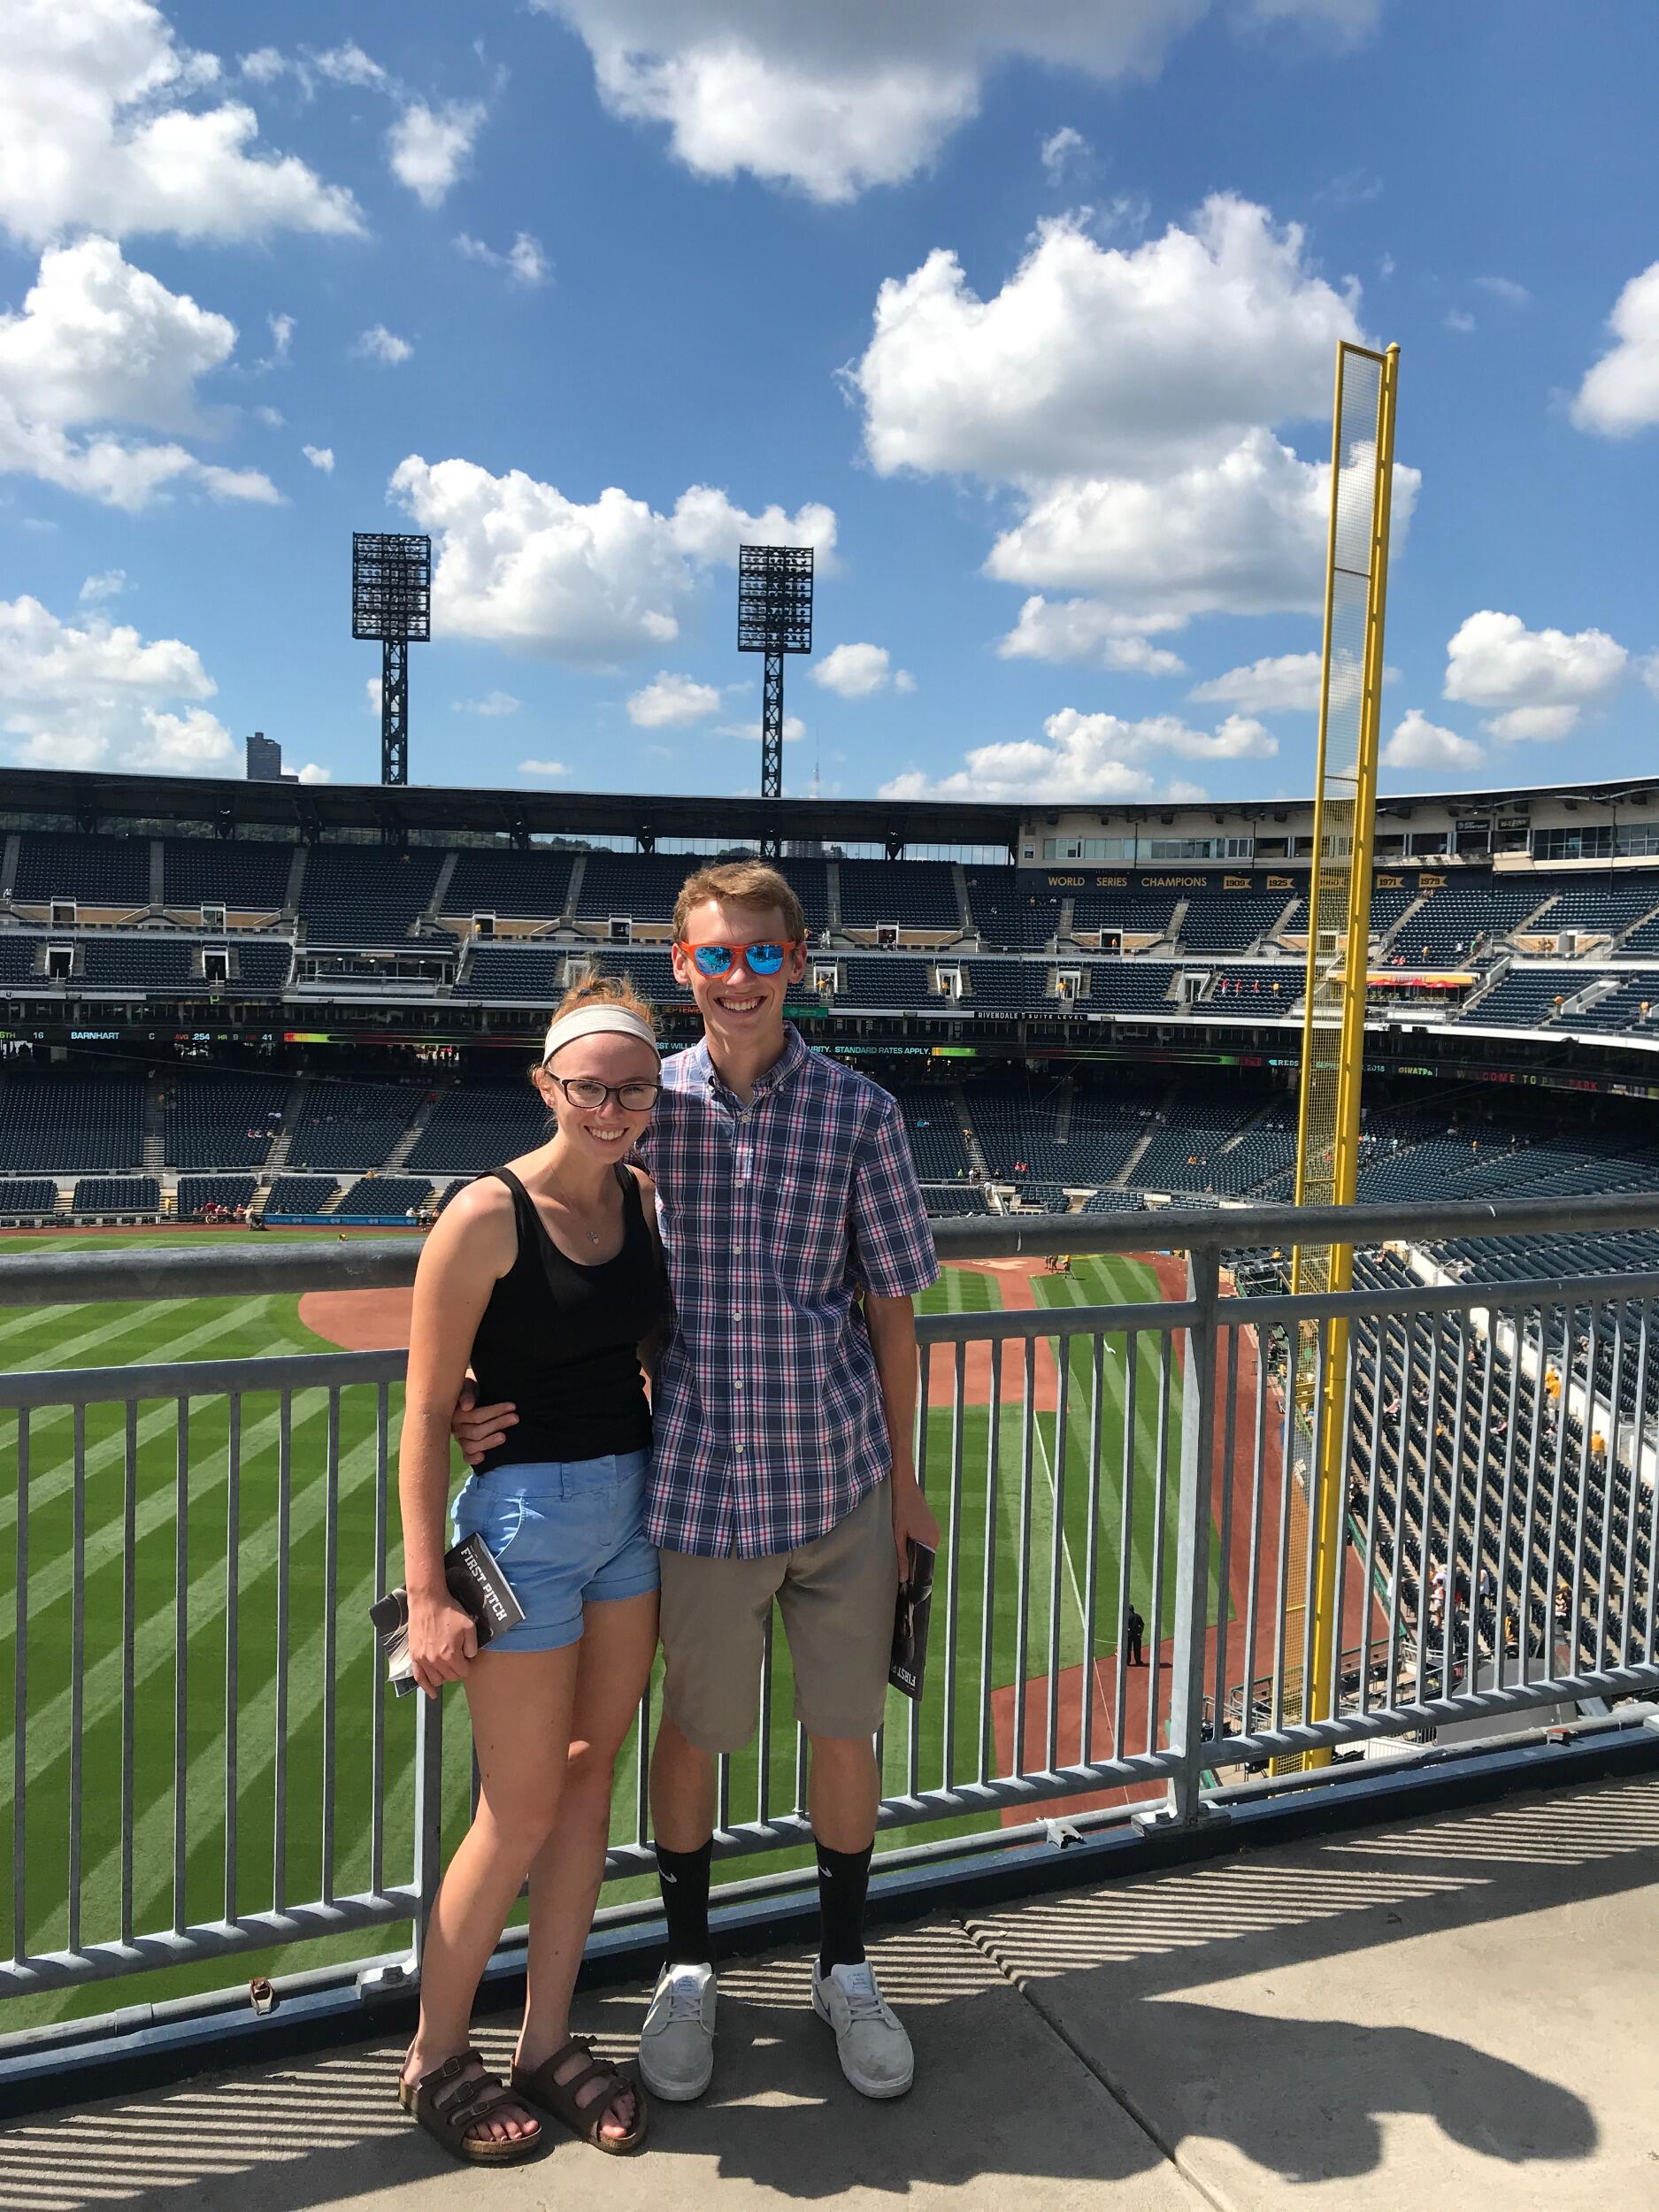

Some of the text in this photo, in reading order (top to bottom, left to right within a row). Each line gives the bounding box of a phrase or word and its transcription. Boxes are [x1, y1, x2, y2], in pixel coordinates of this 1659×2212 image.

[1048, 877, 1208, 887] WORLD SERIES CHAMPIONS
[149, 1033, 156, 1041] C
[1523, 1075, 1537, 1085] TO
[460, 1547, 508, 1622] FIRST PITCH
[896, 1667, 916, 1687] FIRST
